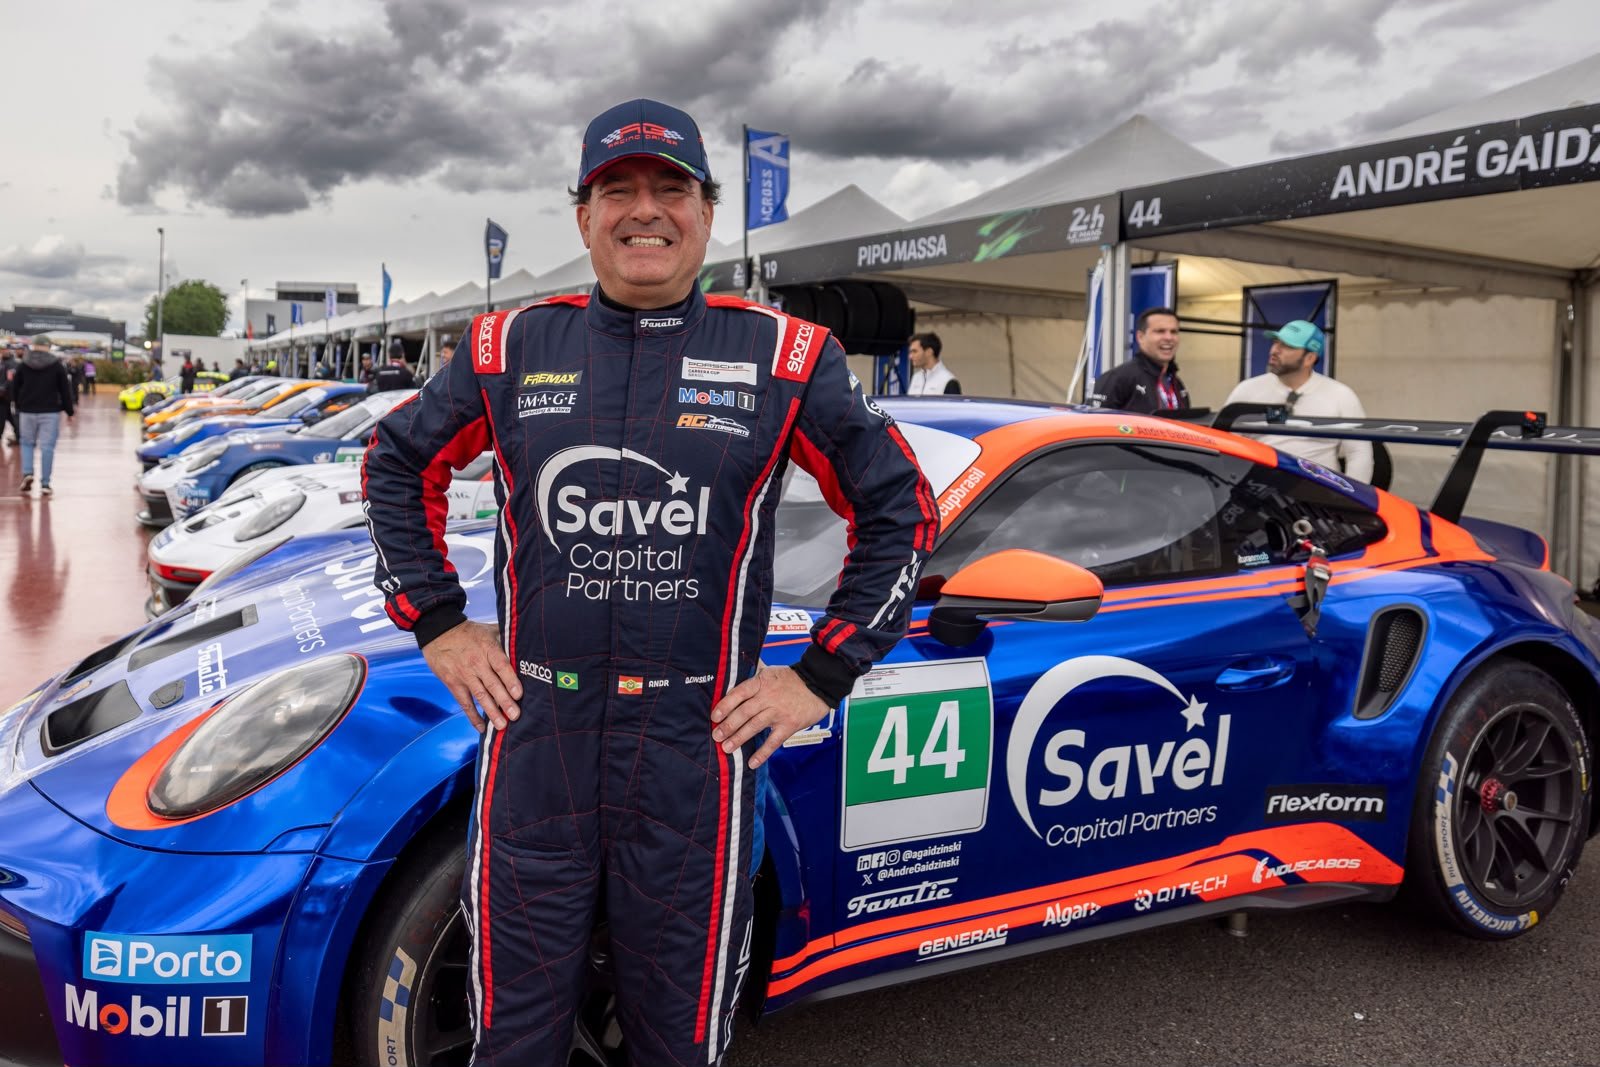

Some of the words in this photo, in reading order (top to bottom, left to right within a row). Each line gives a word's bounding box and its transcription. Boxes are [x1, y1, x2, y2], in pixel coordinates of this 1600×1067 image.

[607, 134, 640, 149] RACING
[645, 134, 678, 147] DRIVER
[1330, 135, 1468, 200] ANDRÉ
[1128, 197, 1162, 228] 44
[857, 242, 891, 267] PIPO
[893, 234, 947, 262] MASSA
[764, 260, 777, 279] 19
[640, 317, 684, 328] Fanatic
[479, 315, 496, 366] sparco
[787, 324, 815, 375] sparco
[523, 373, 577, 385] FREMAX
[678, 388, 734, 407] Mobil
[677, 414, 707, 427] AG
[556, 485, 711, 536] Savel
[570, 543, 683, 576] Capital
[566, 572, 699, 601] Partners
[519, 660, 552, 680] sparco
[867, 700, 966, 785] 44
[1039, 714, 1232, 807] Savel
[1267, 792, 1384, 814] Flexform
[1046, 814, 1128, 848] Capital
[1129, 805, 1218, 834] Partners
[902, 840, 963, 862] @agaidzinski
[877, 856, 961, 882] @AndreGaidzinski
[847, 877, 959, 919] Fanatic
[1455, 888, 1517, 932] MICHELIN
[1043, 903, 1090, 927] Algar
[917, 923, 1009, 956] GENERAC
[128, 941, 242, 978] Porto
[65, 983, 190, 1037] Mobil
